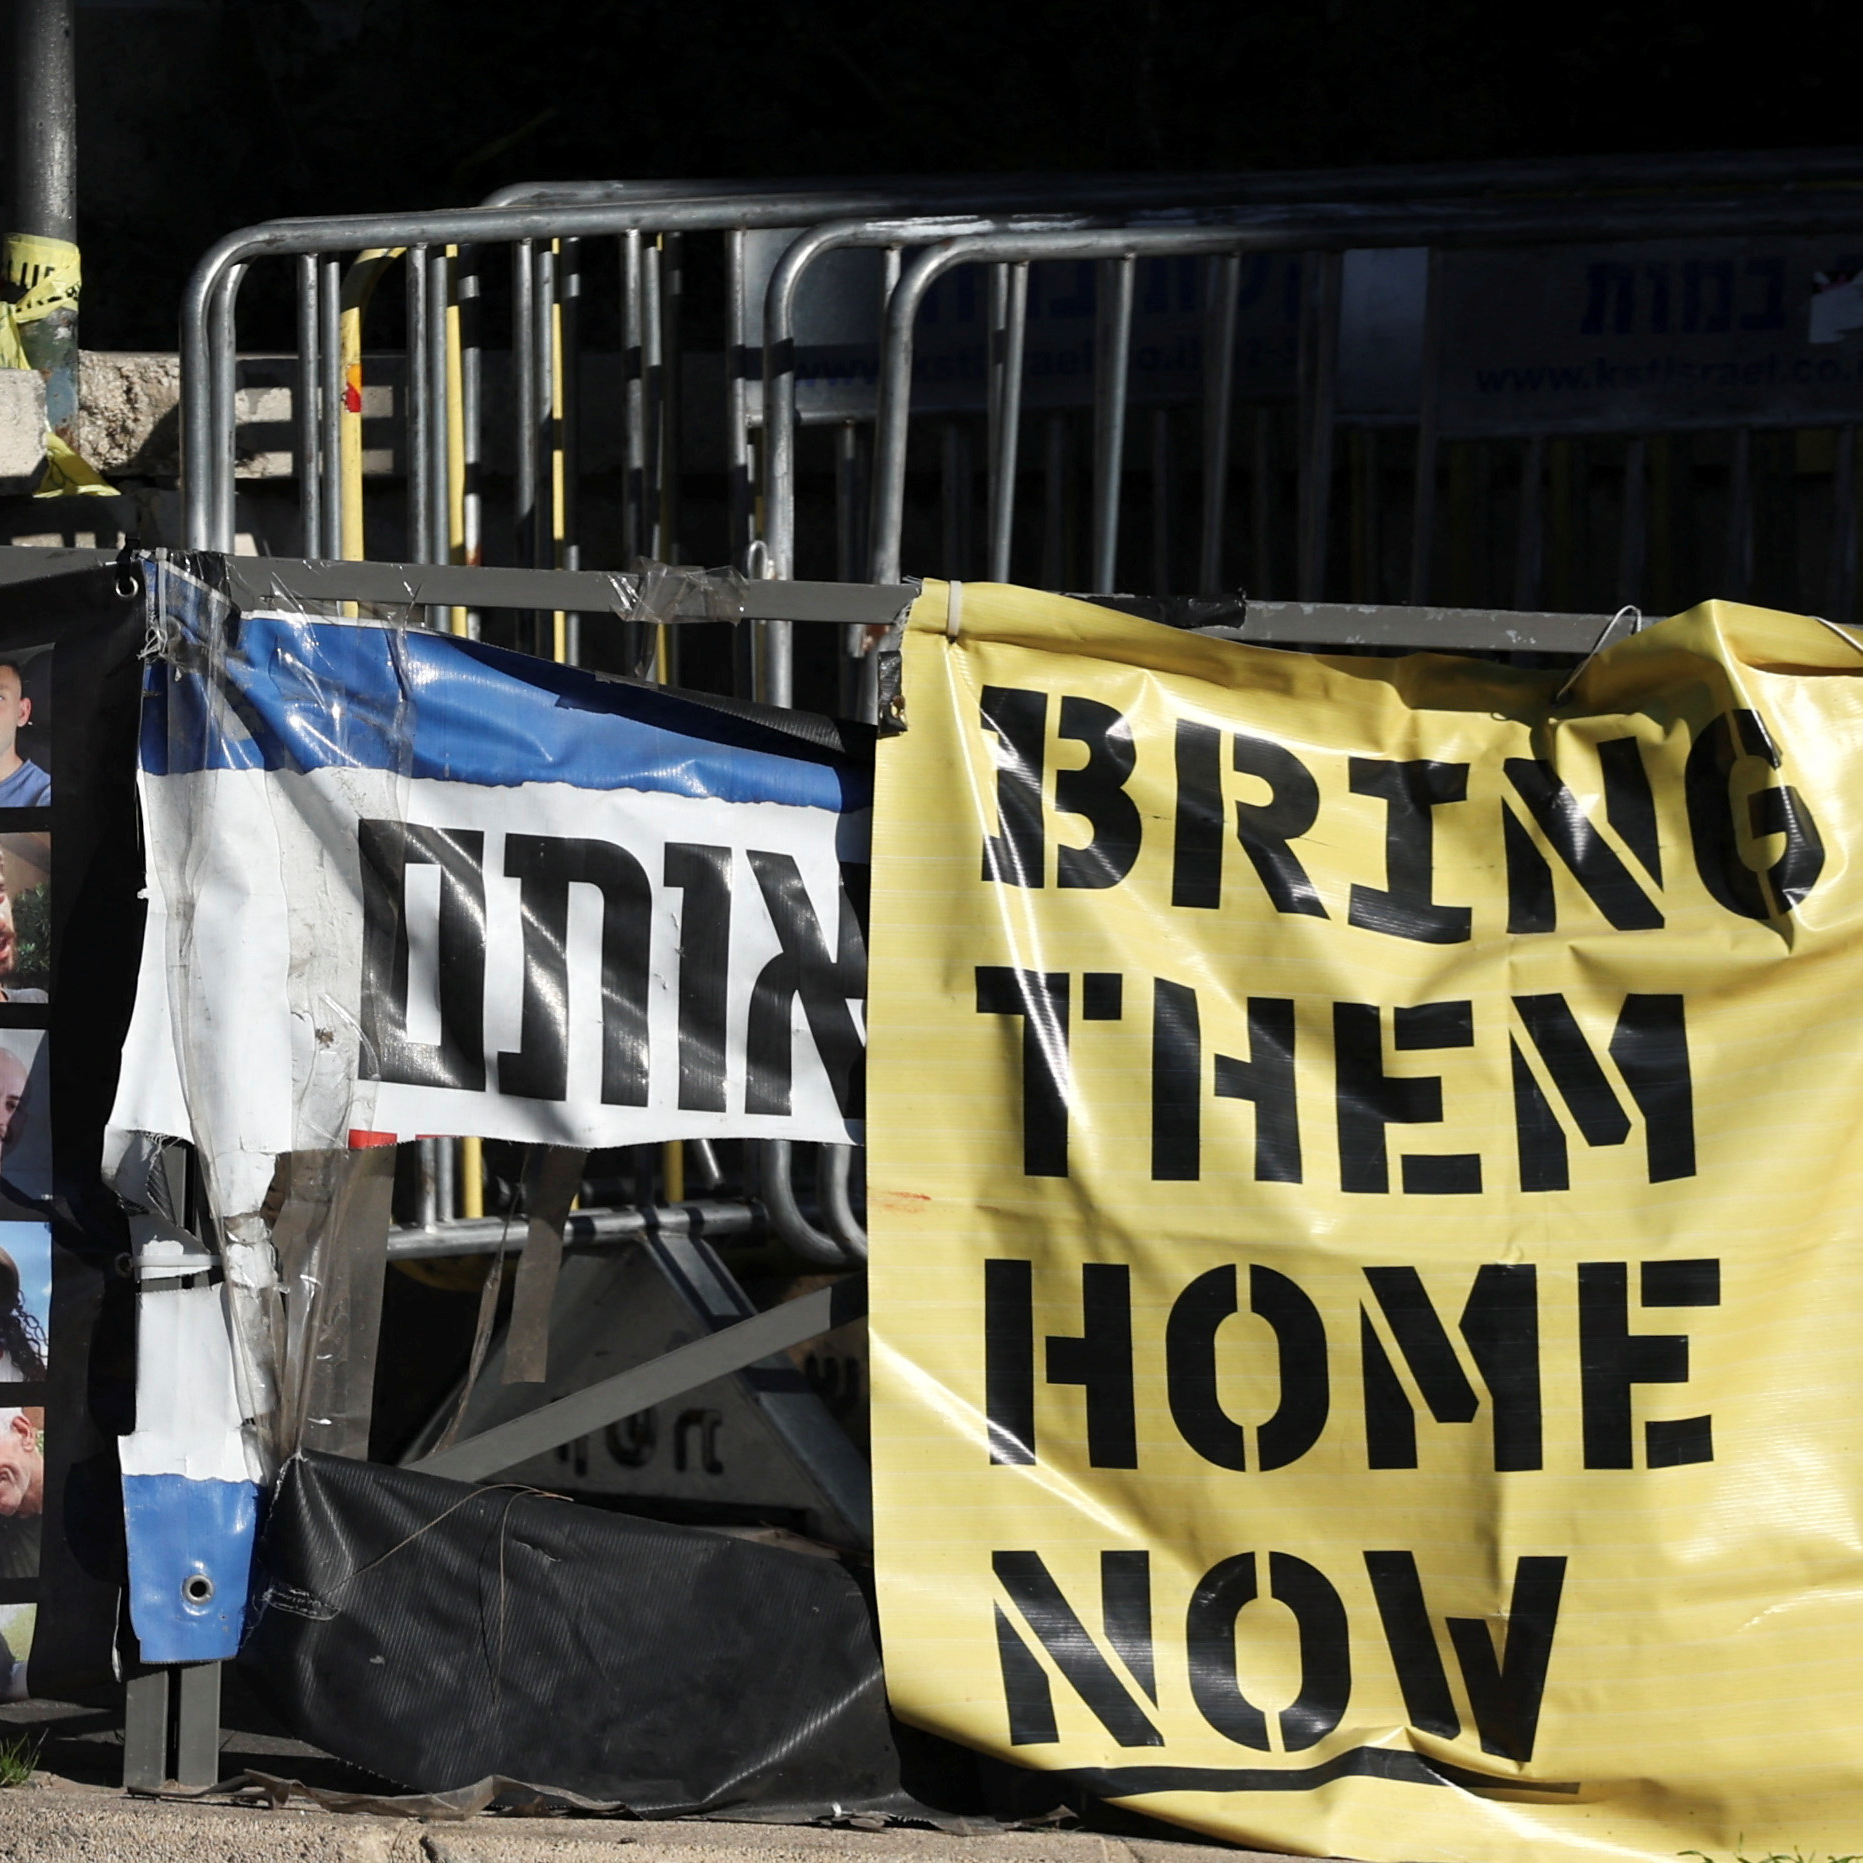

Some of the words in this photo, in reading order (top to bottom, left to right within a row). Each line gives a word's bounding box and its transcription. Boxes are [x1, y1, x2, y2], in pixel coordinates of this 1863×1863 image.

[1581, 256, 1787, 336] במות
[980, 685, 1824, 944] BRING
[357, 819, 867, 1117] אותם
[975, 967, 1697, 1194] THEM
[984, 1258, 1721, 1472] HOME
[991, 1550, 1568, 1763] NOW
